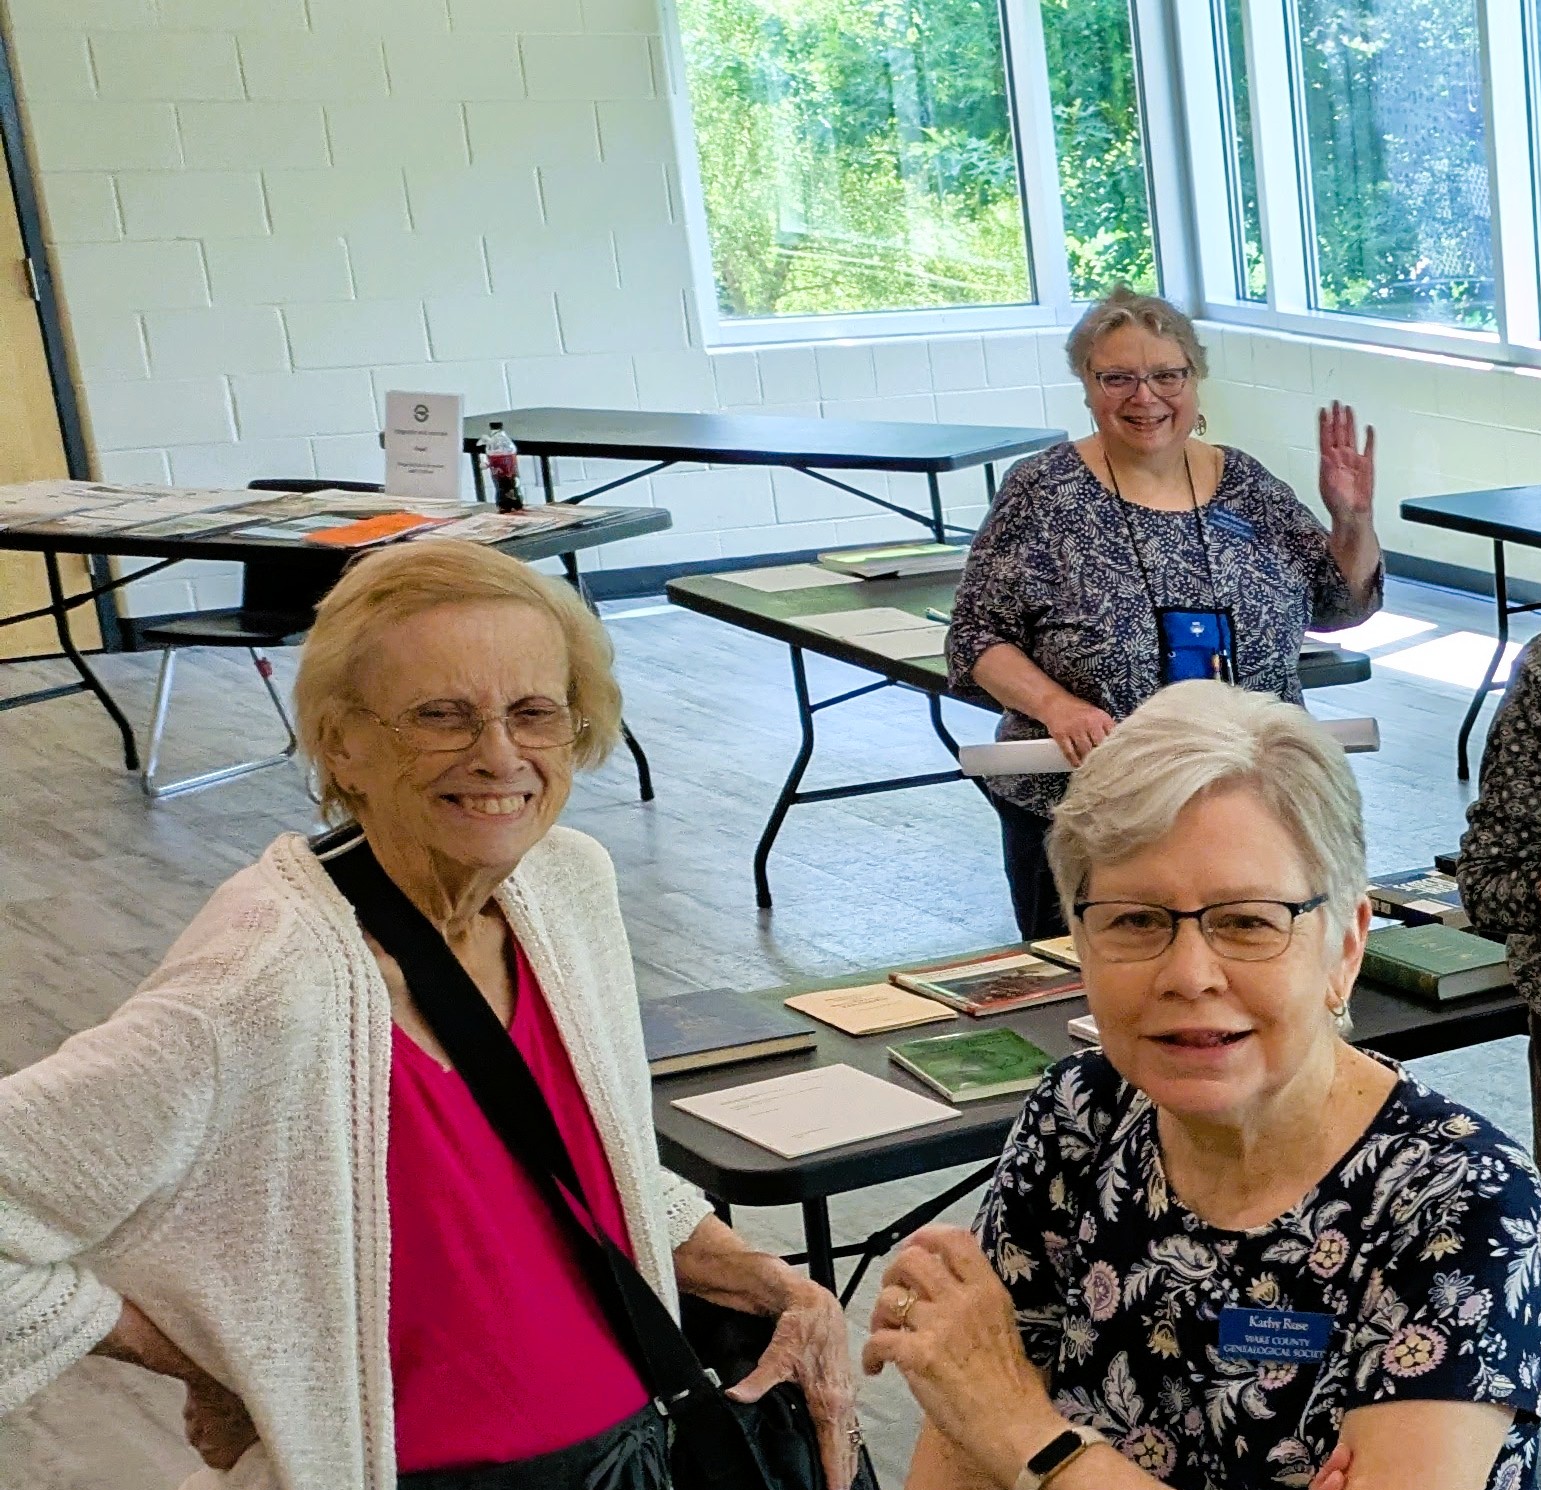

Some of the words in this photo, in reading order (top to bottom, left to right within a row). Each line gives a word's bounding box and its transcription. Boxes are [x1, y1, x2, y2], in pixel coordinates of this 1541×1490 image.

[1249, 1315, 1281, 1331] Kathy
[1272, 1337, 1310, 1347] COUNTY
[1223, 1344, 1291, 1357] GENEALOGICAL
